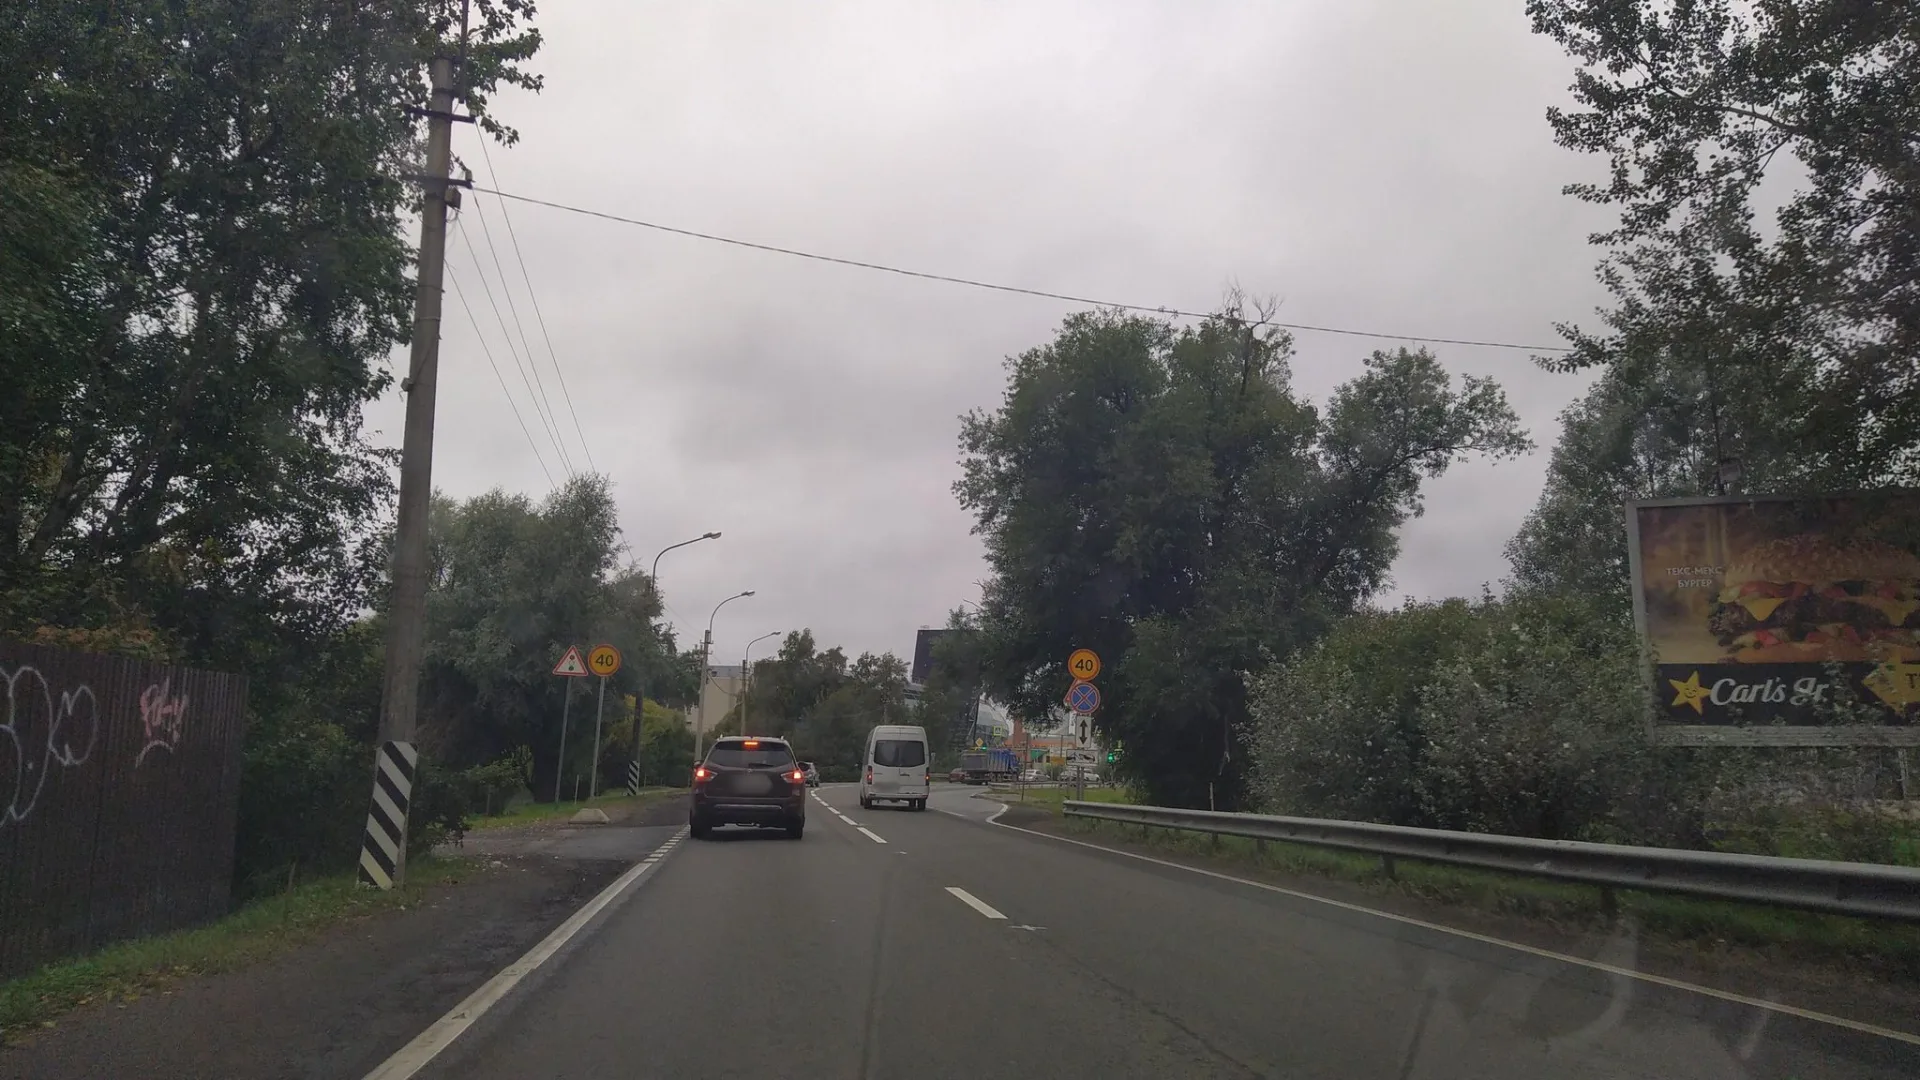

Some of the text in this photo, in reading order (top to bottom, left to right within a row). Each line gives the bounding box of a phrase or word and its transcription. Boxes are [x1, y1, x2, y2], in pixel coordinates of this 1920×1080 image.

[1665, 566, 1723, 576] ТЕКС-МЕКС
[1678, 579, 1712, 588] БУРГЕР
[595, 654, 614, 667] 40
[1075, 659, 1094, 672] 40
[1709, 677, 1787, 706] Carl's
